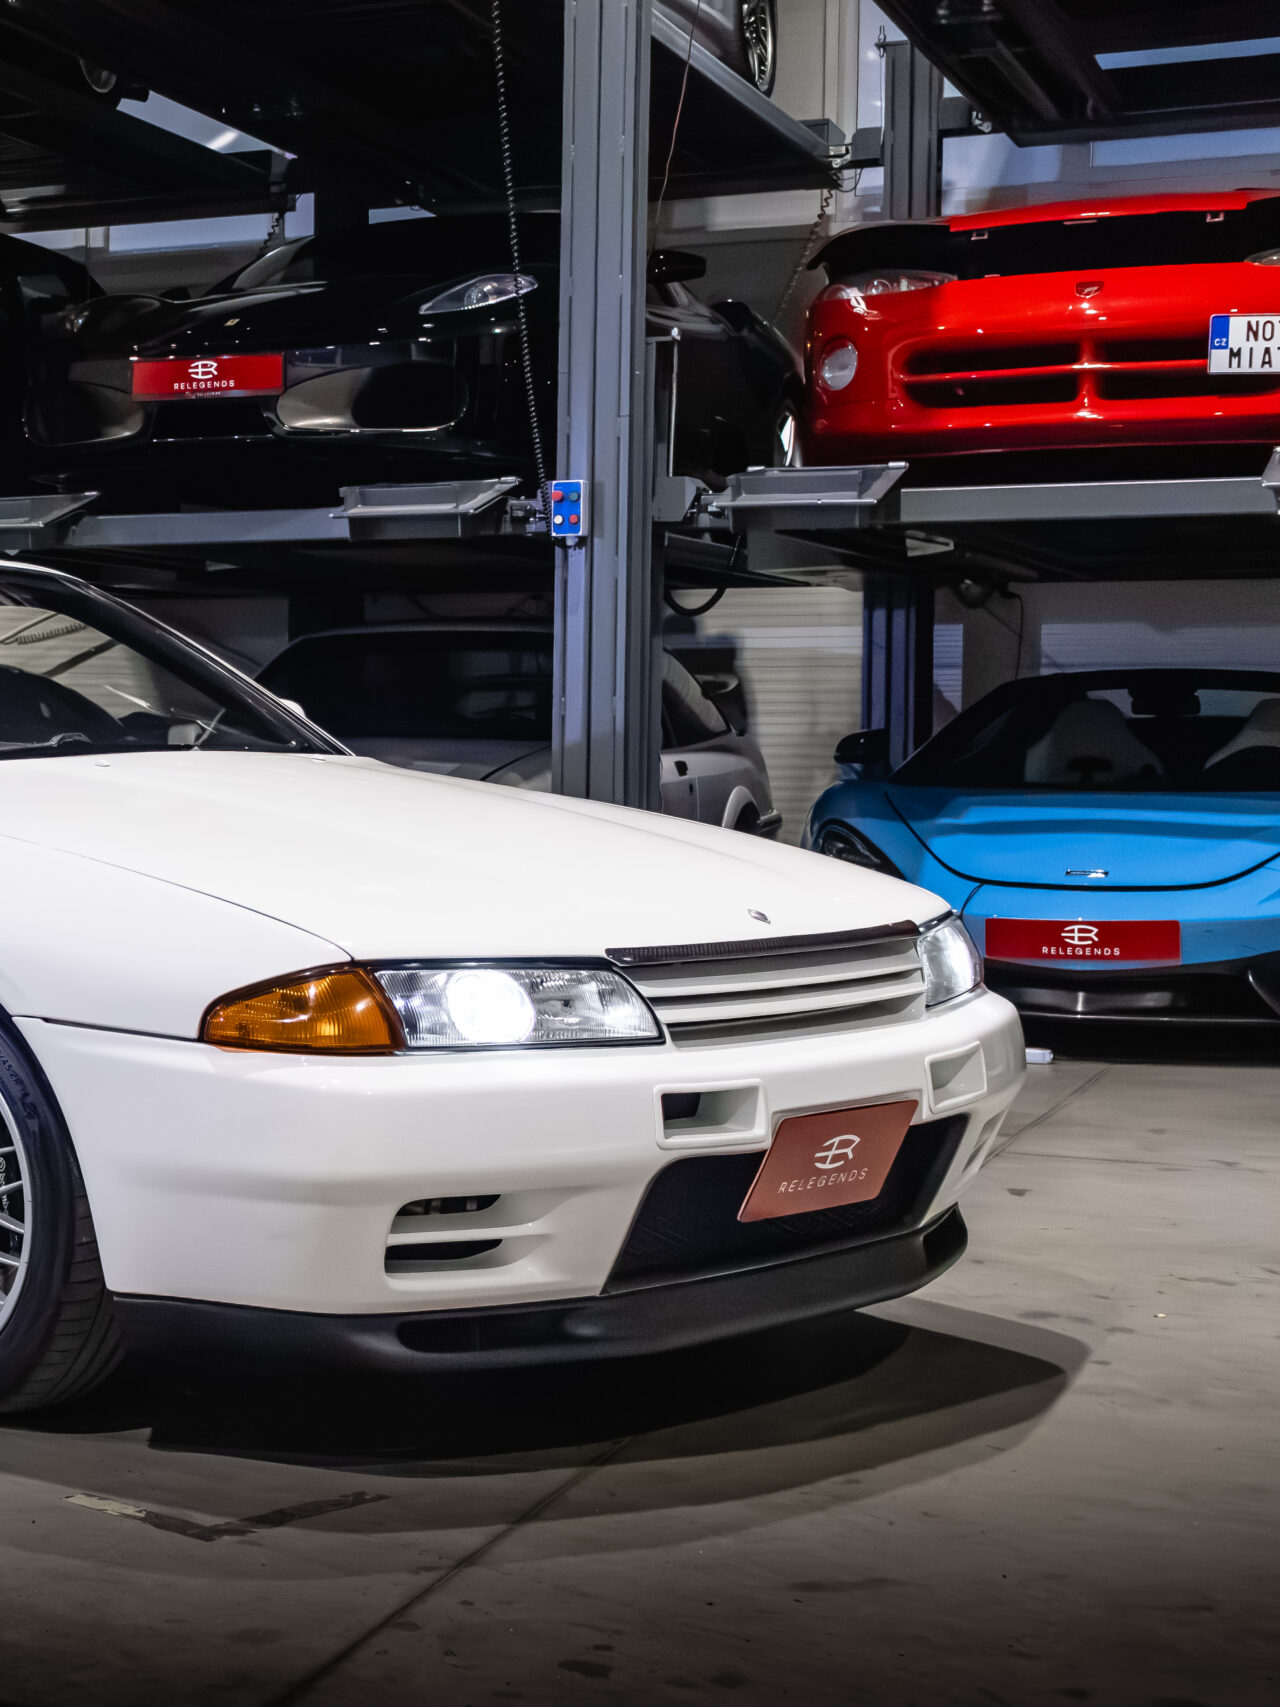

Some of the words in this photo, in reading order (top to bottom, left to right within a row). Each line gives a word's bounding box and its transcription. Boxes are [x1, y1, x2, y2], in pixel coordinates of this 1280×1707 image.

[1246, 320, 1280, 341] NO
[1214, 338, 1227, 346] CZ
[1228, 346, 1280, 368] MIA
[174, 380, 235, 390] RELEGENDS
[1042, 946, 1120, 956] RELEGENDS
[777, 1168, 868, 1193] RELEGENDS
